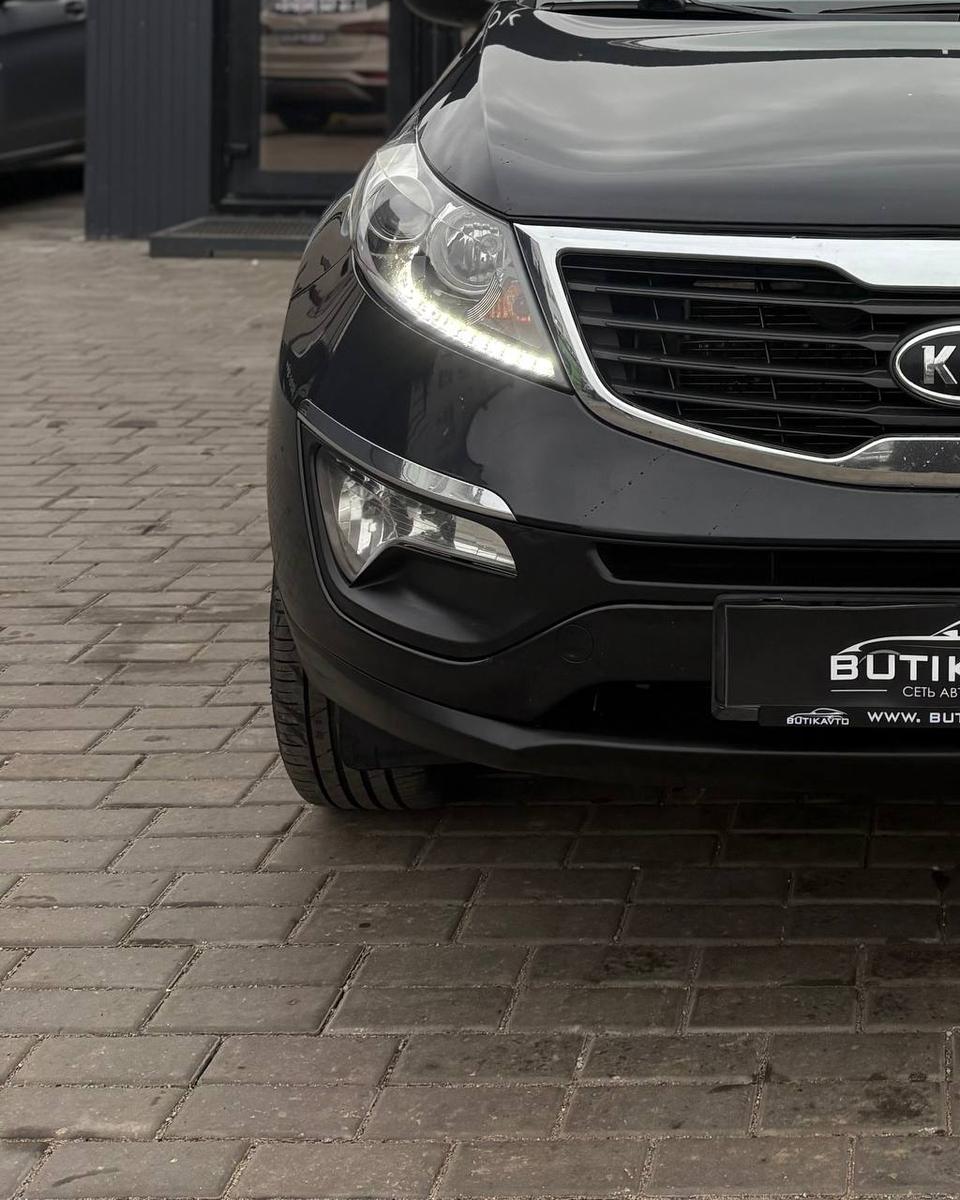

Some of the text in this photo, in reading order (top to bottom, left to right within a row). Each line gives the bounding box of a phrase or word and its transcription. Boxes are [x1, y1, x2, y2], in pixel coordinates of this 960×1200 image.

[902, 686, 936, 698] СЕТЬ
[786, 717, 850, 726] BUTIKAVTO
[867, 711, 921, 724] WWW.
